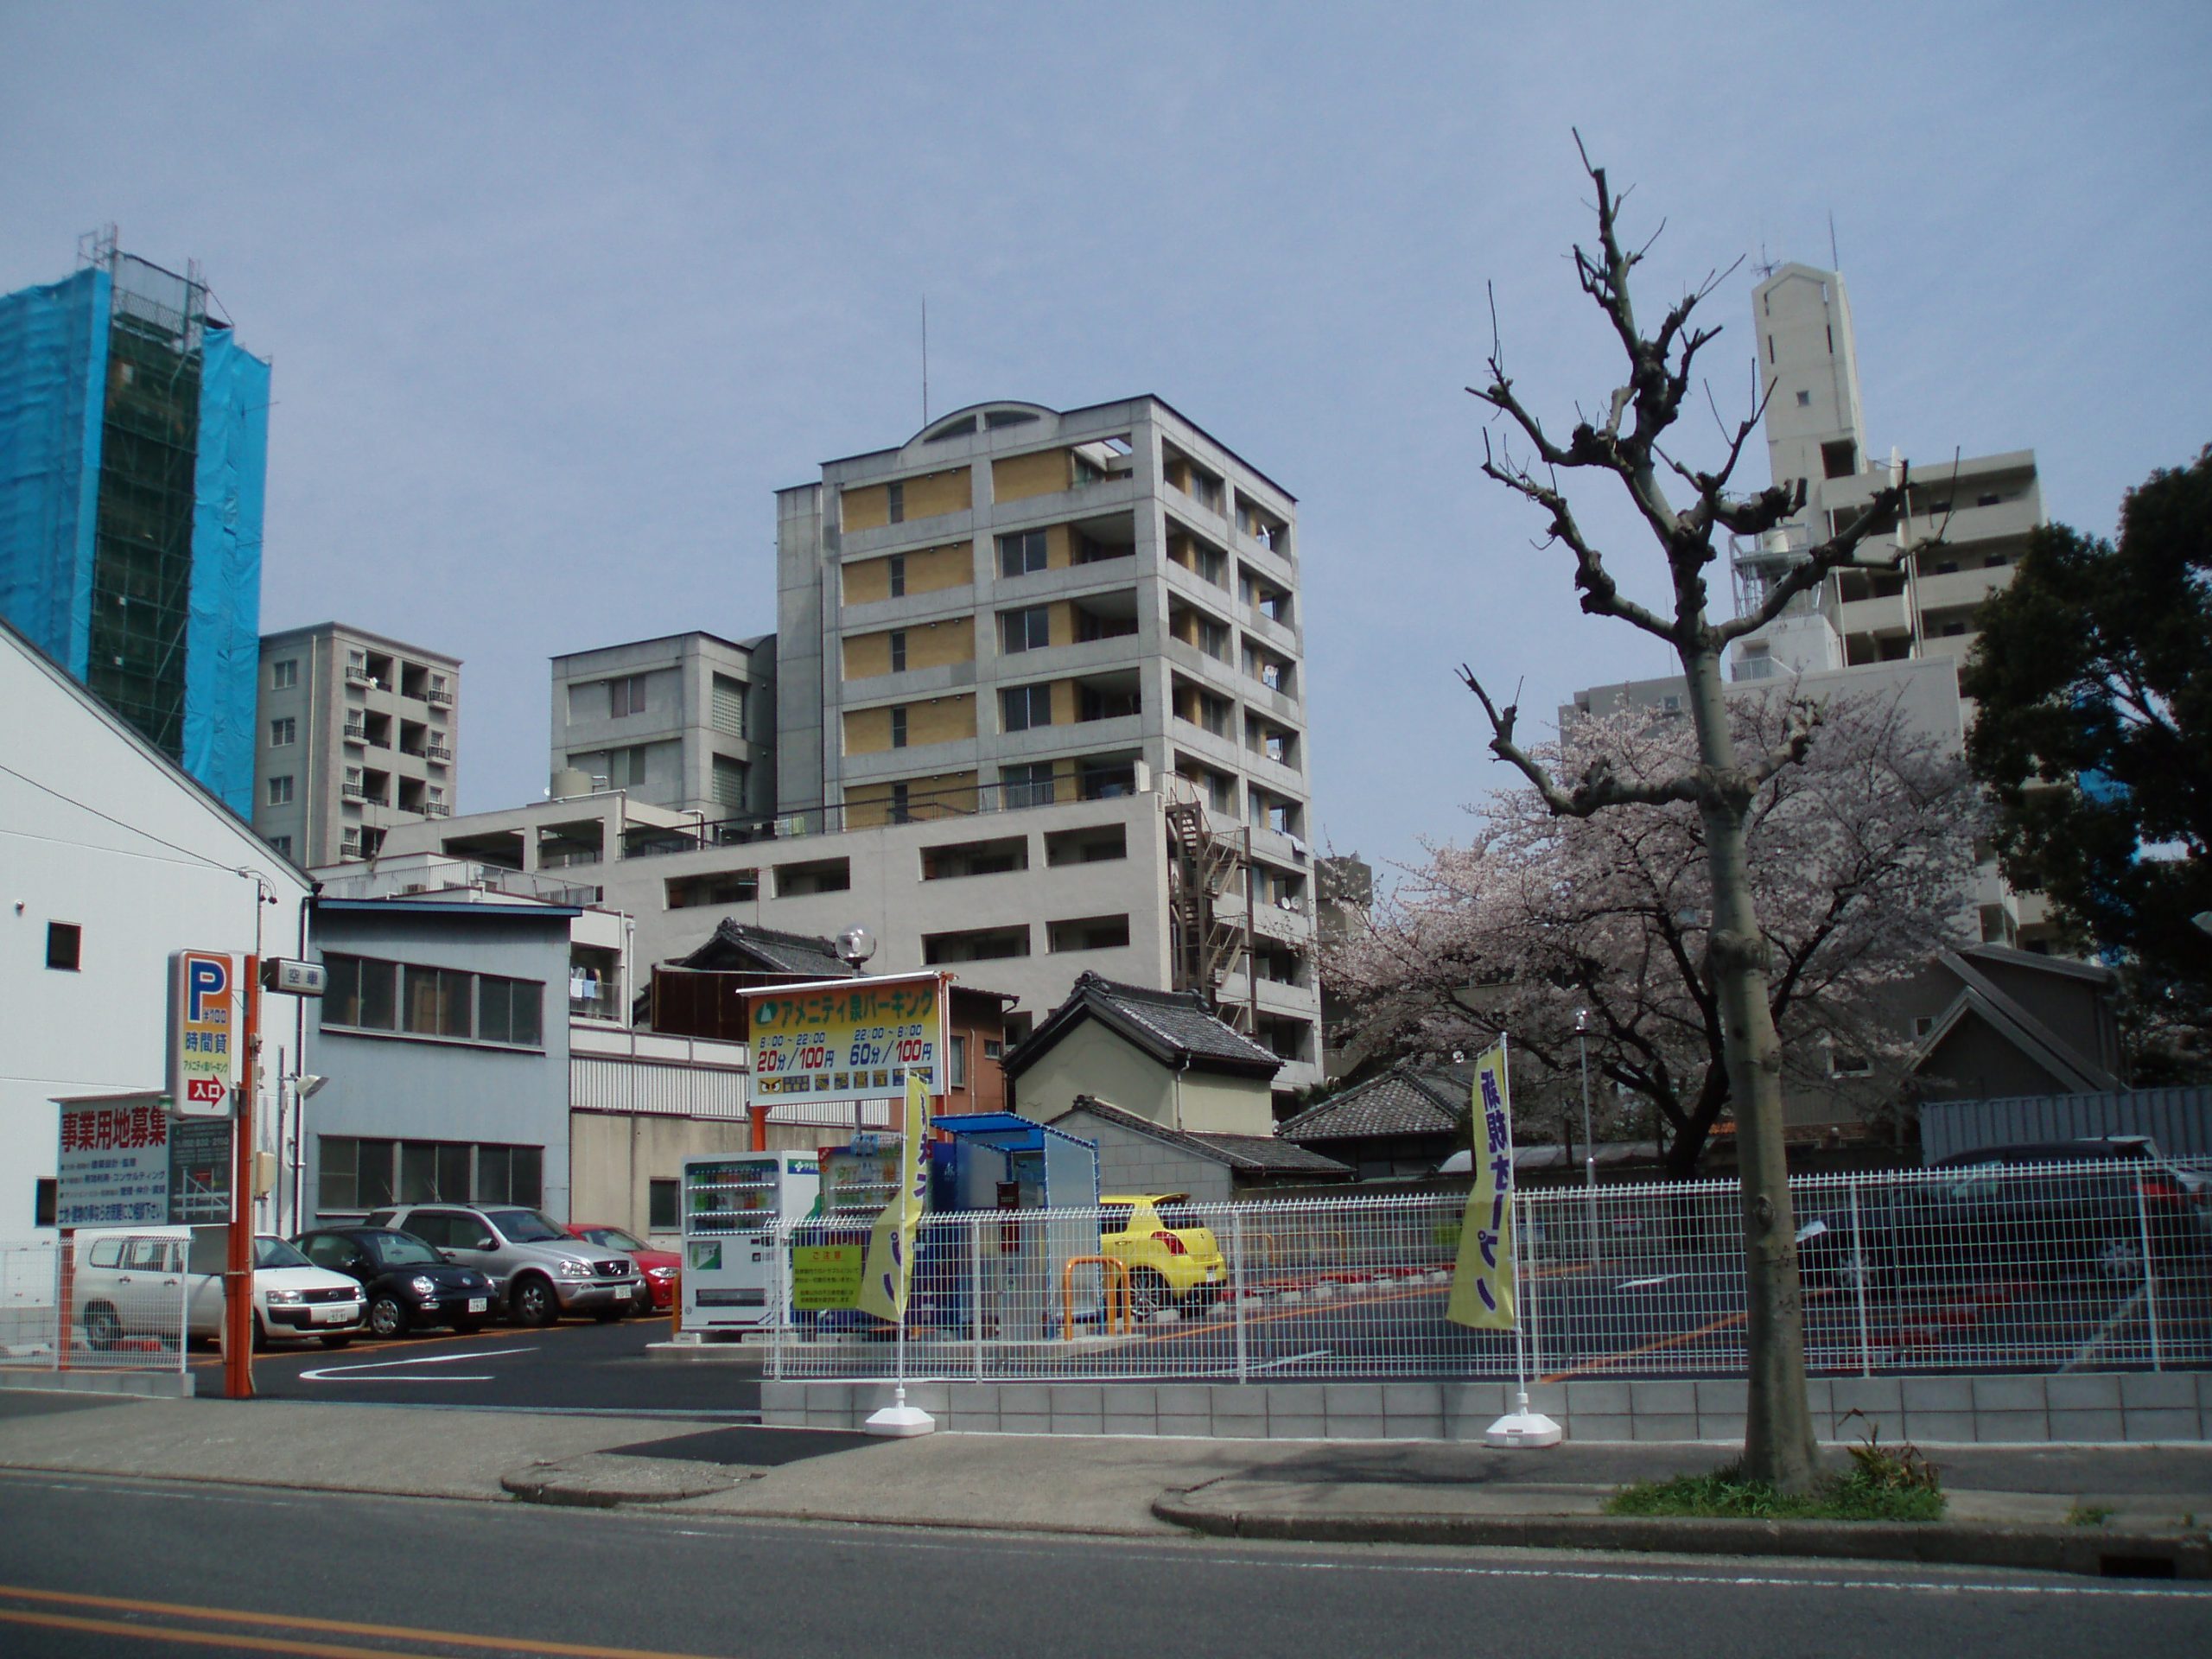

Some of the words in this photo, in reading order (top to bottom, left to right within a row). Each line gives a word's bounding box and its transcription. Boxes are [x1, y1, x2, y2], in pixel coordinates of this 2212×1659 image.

[189, 958, 226, 1023] P
[288, 968, 319, 985] 空車
[781, 988, 933, 1028] アメニティ泉パーキング
[185, 1031, 227, 1054] 時間貸
[193, 1083, 220, 1099] 入口
[61, 1105, 167, 1154] 事業用地募集
